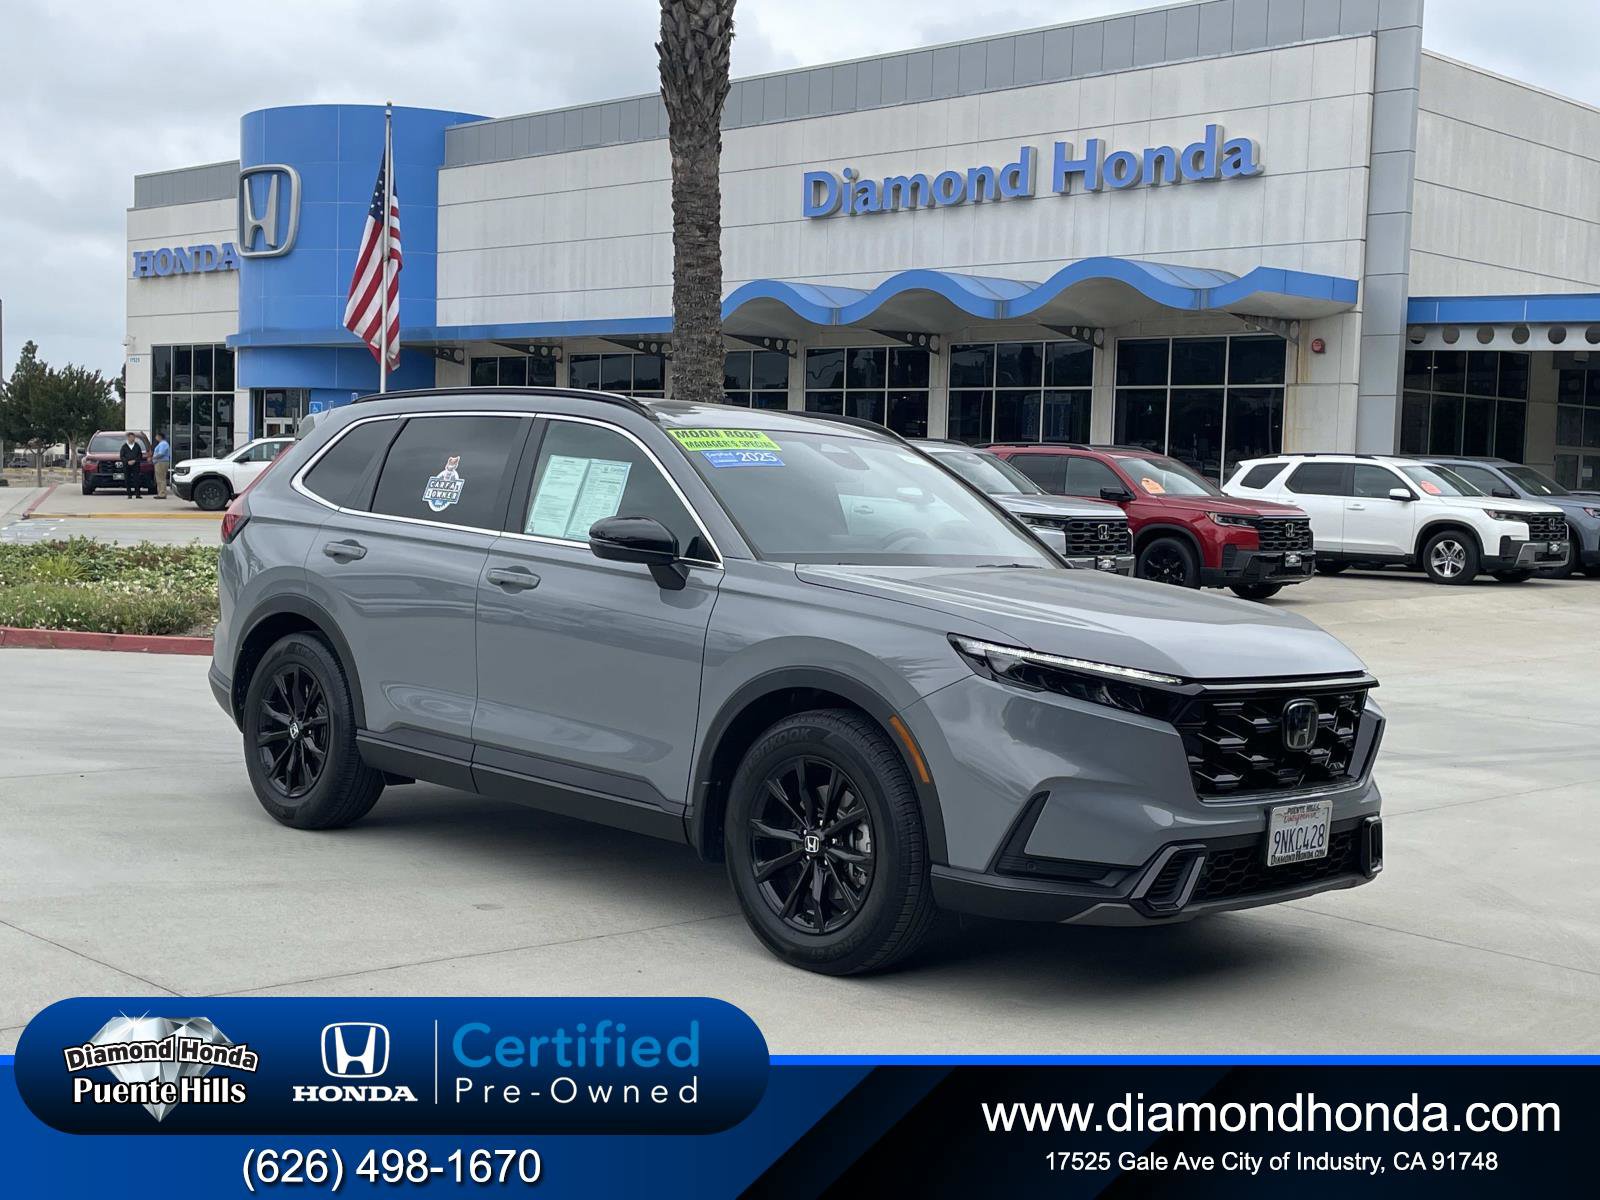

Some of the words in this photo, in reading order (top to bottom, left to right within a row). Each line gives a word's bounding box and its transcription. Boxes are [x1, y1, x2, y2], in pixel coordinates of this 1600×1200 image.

[803, 147, 1035, 217] Diamond
[1053, 124, 1264, 193] Honda
[133, 243, 239, 278] HONDA
[674, 430, 721, 438] MOON
[725, 430, 761, 438] ROOF
[685, 440, 738, 448] MANAGER'S
[739, 440, 778, 448] SPECIAL
[736, 452, 777, 462] 2025
[1274, 824, 1325, 854] 9NKC428
